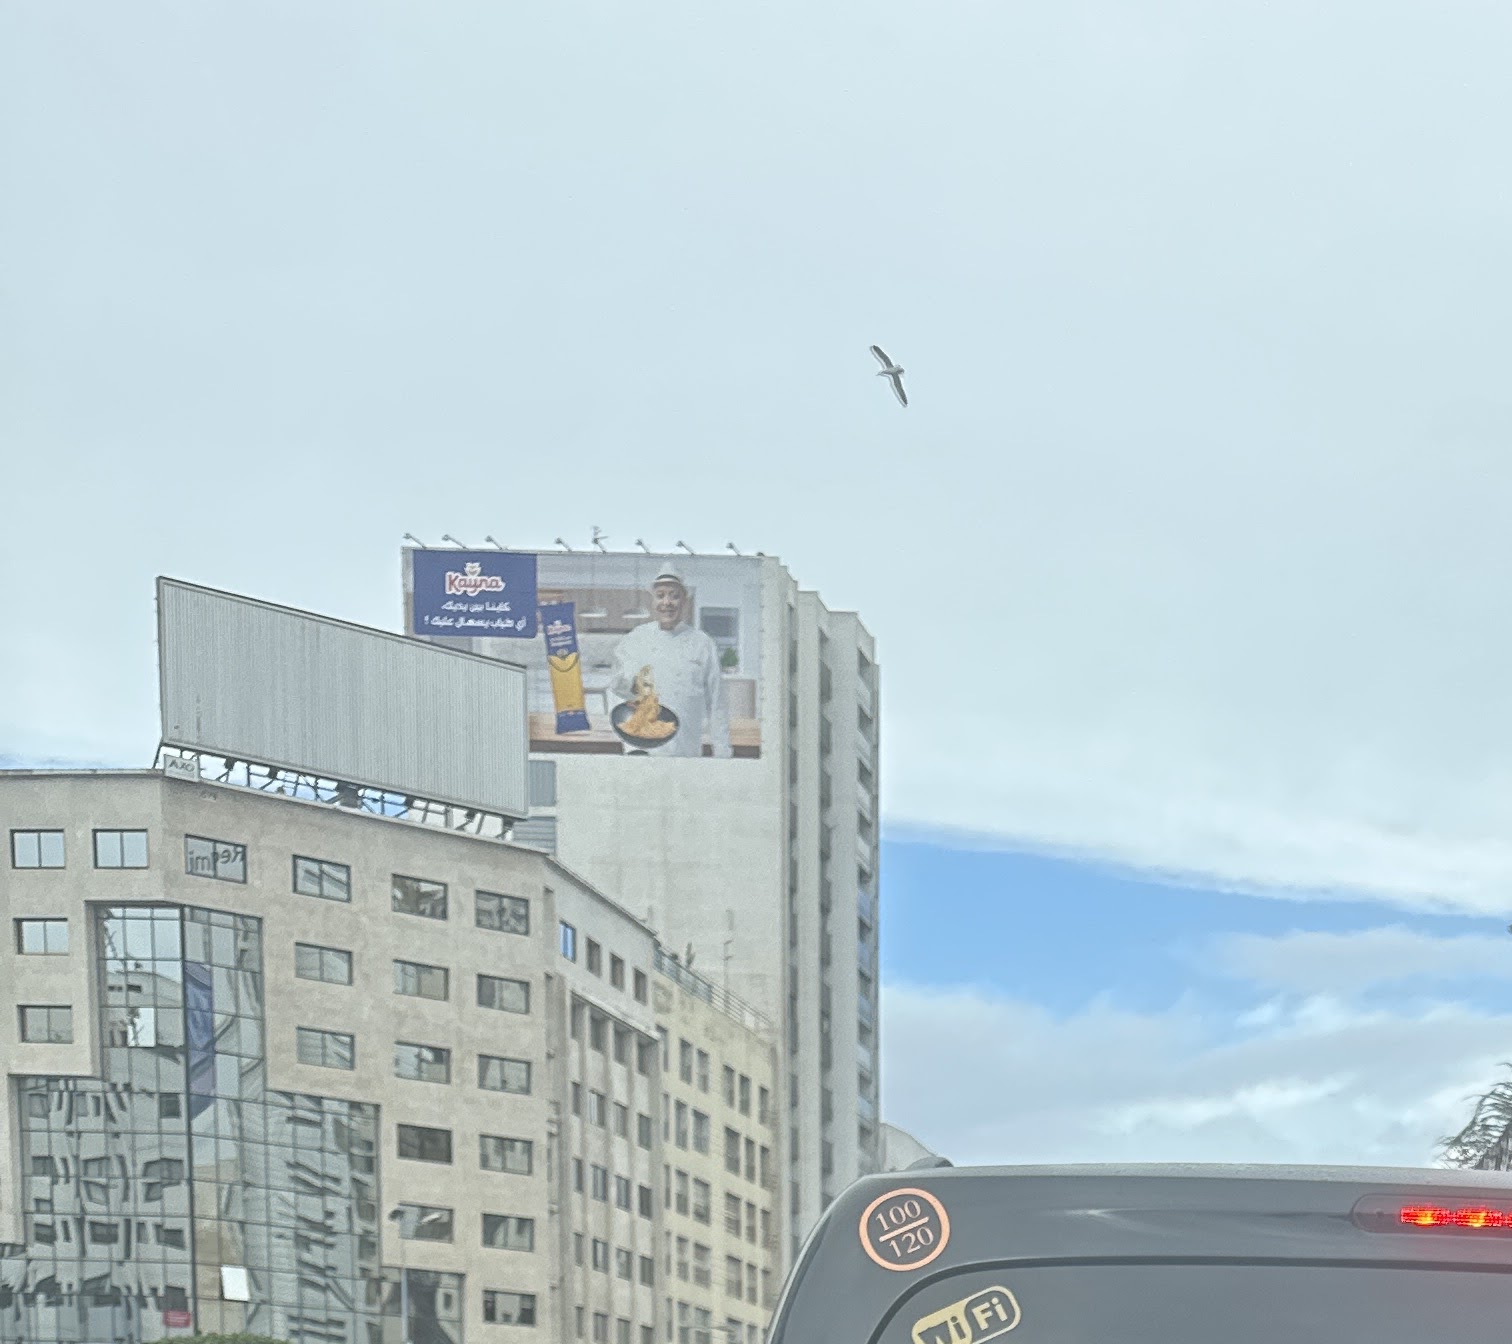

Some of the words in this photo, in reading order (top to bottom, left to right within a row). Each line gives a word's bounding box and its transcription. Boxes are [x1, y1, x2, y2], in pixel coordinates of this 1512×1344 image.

[446, 572, 504, 595] Kayna
[876, 1200, 921, 1231] 100
[889, 1227, 934, 1258] 120
